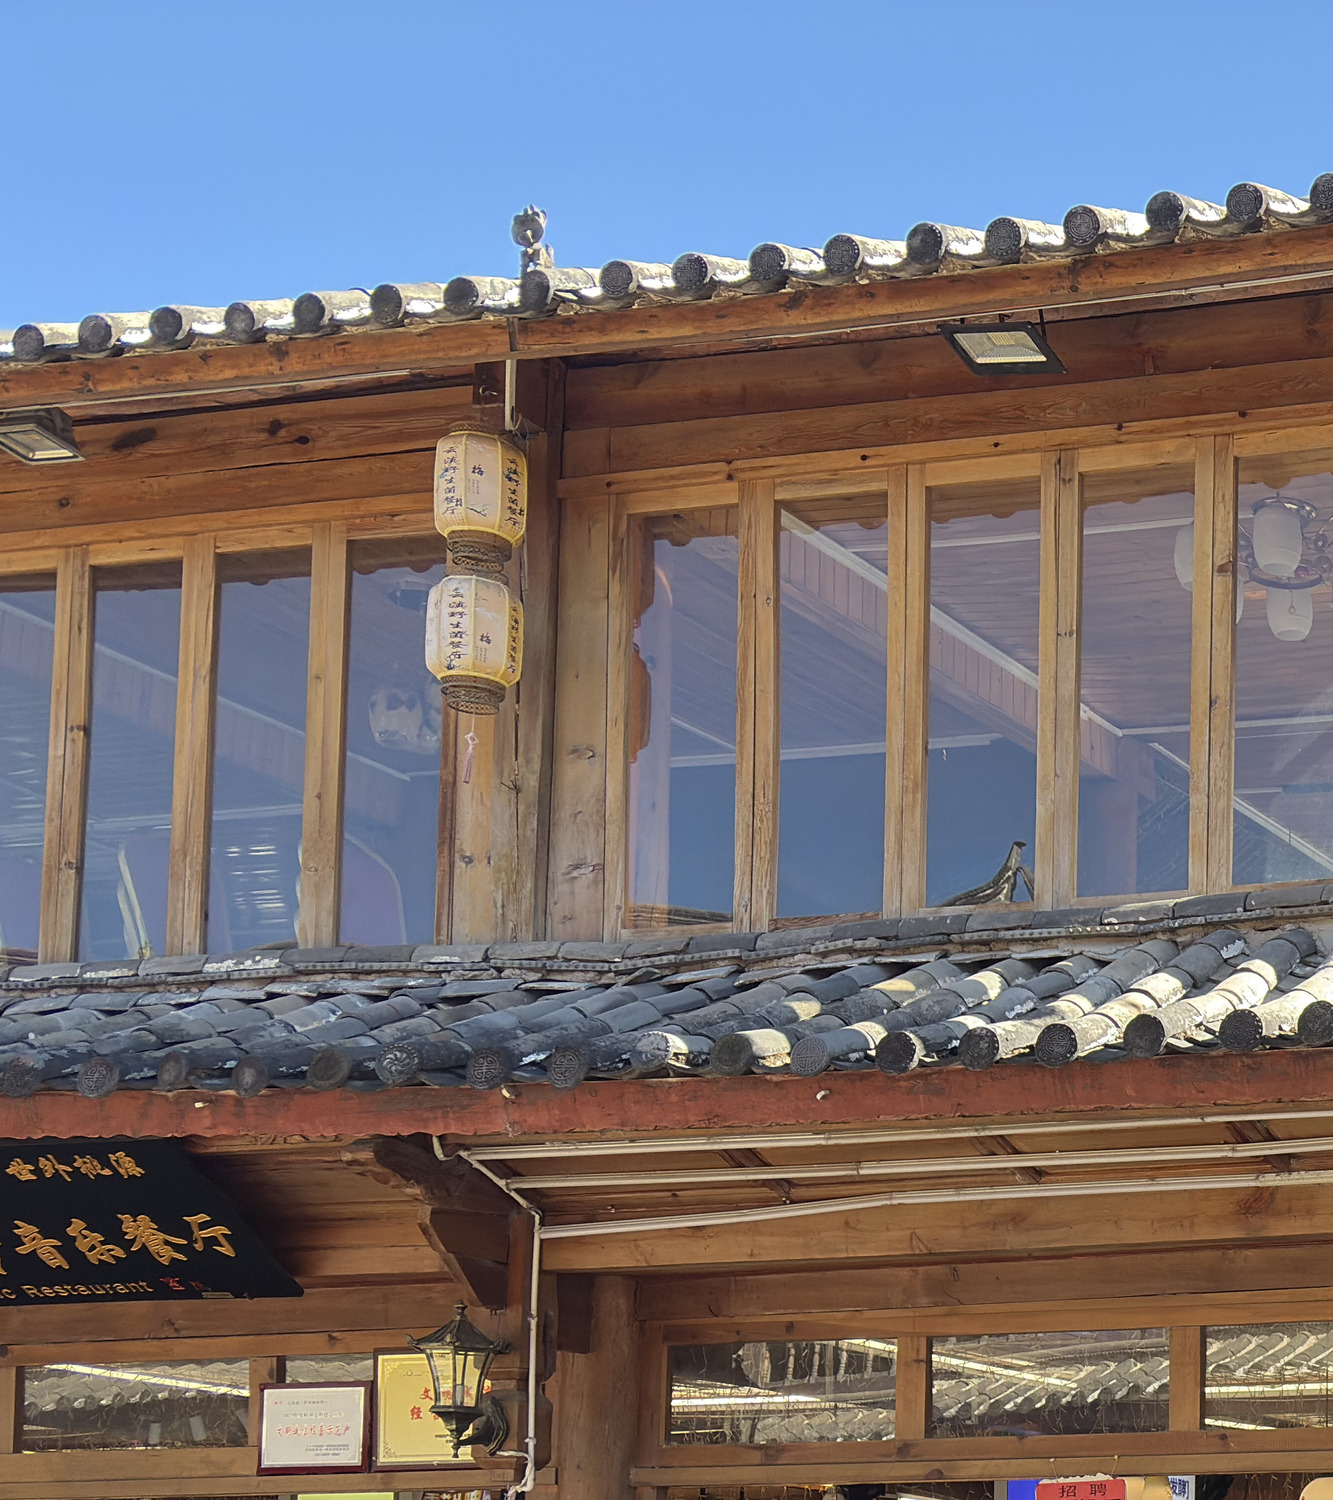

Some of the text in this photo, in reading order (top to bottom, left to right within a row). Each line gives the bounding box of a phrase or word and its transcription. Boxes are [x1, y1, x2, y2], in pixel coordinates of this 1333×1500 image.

[4, 1151, 146, 1182] 世外桃源
[0, 1213, 236, 1276] 音乐餐厅
[21, 1279, 154, 1299] Restaurant
[1059, 1483, 1107, 1498] 招聘
